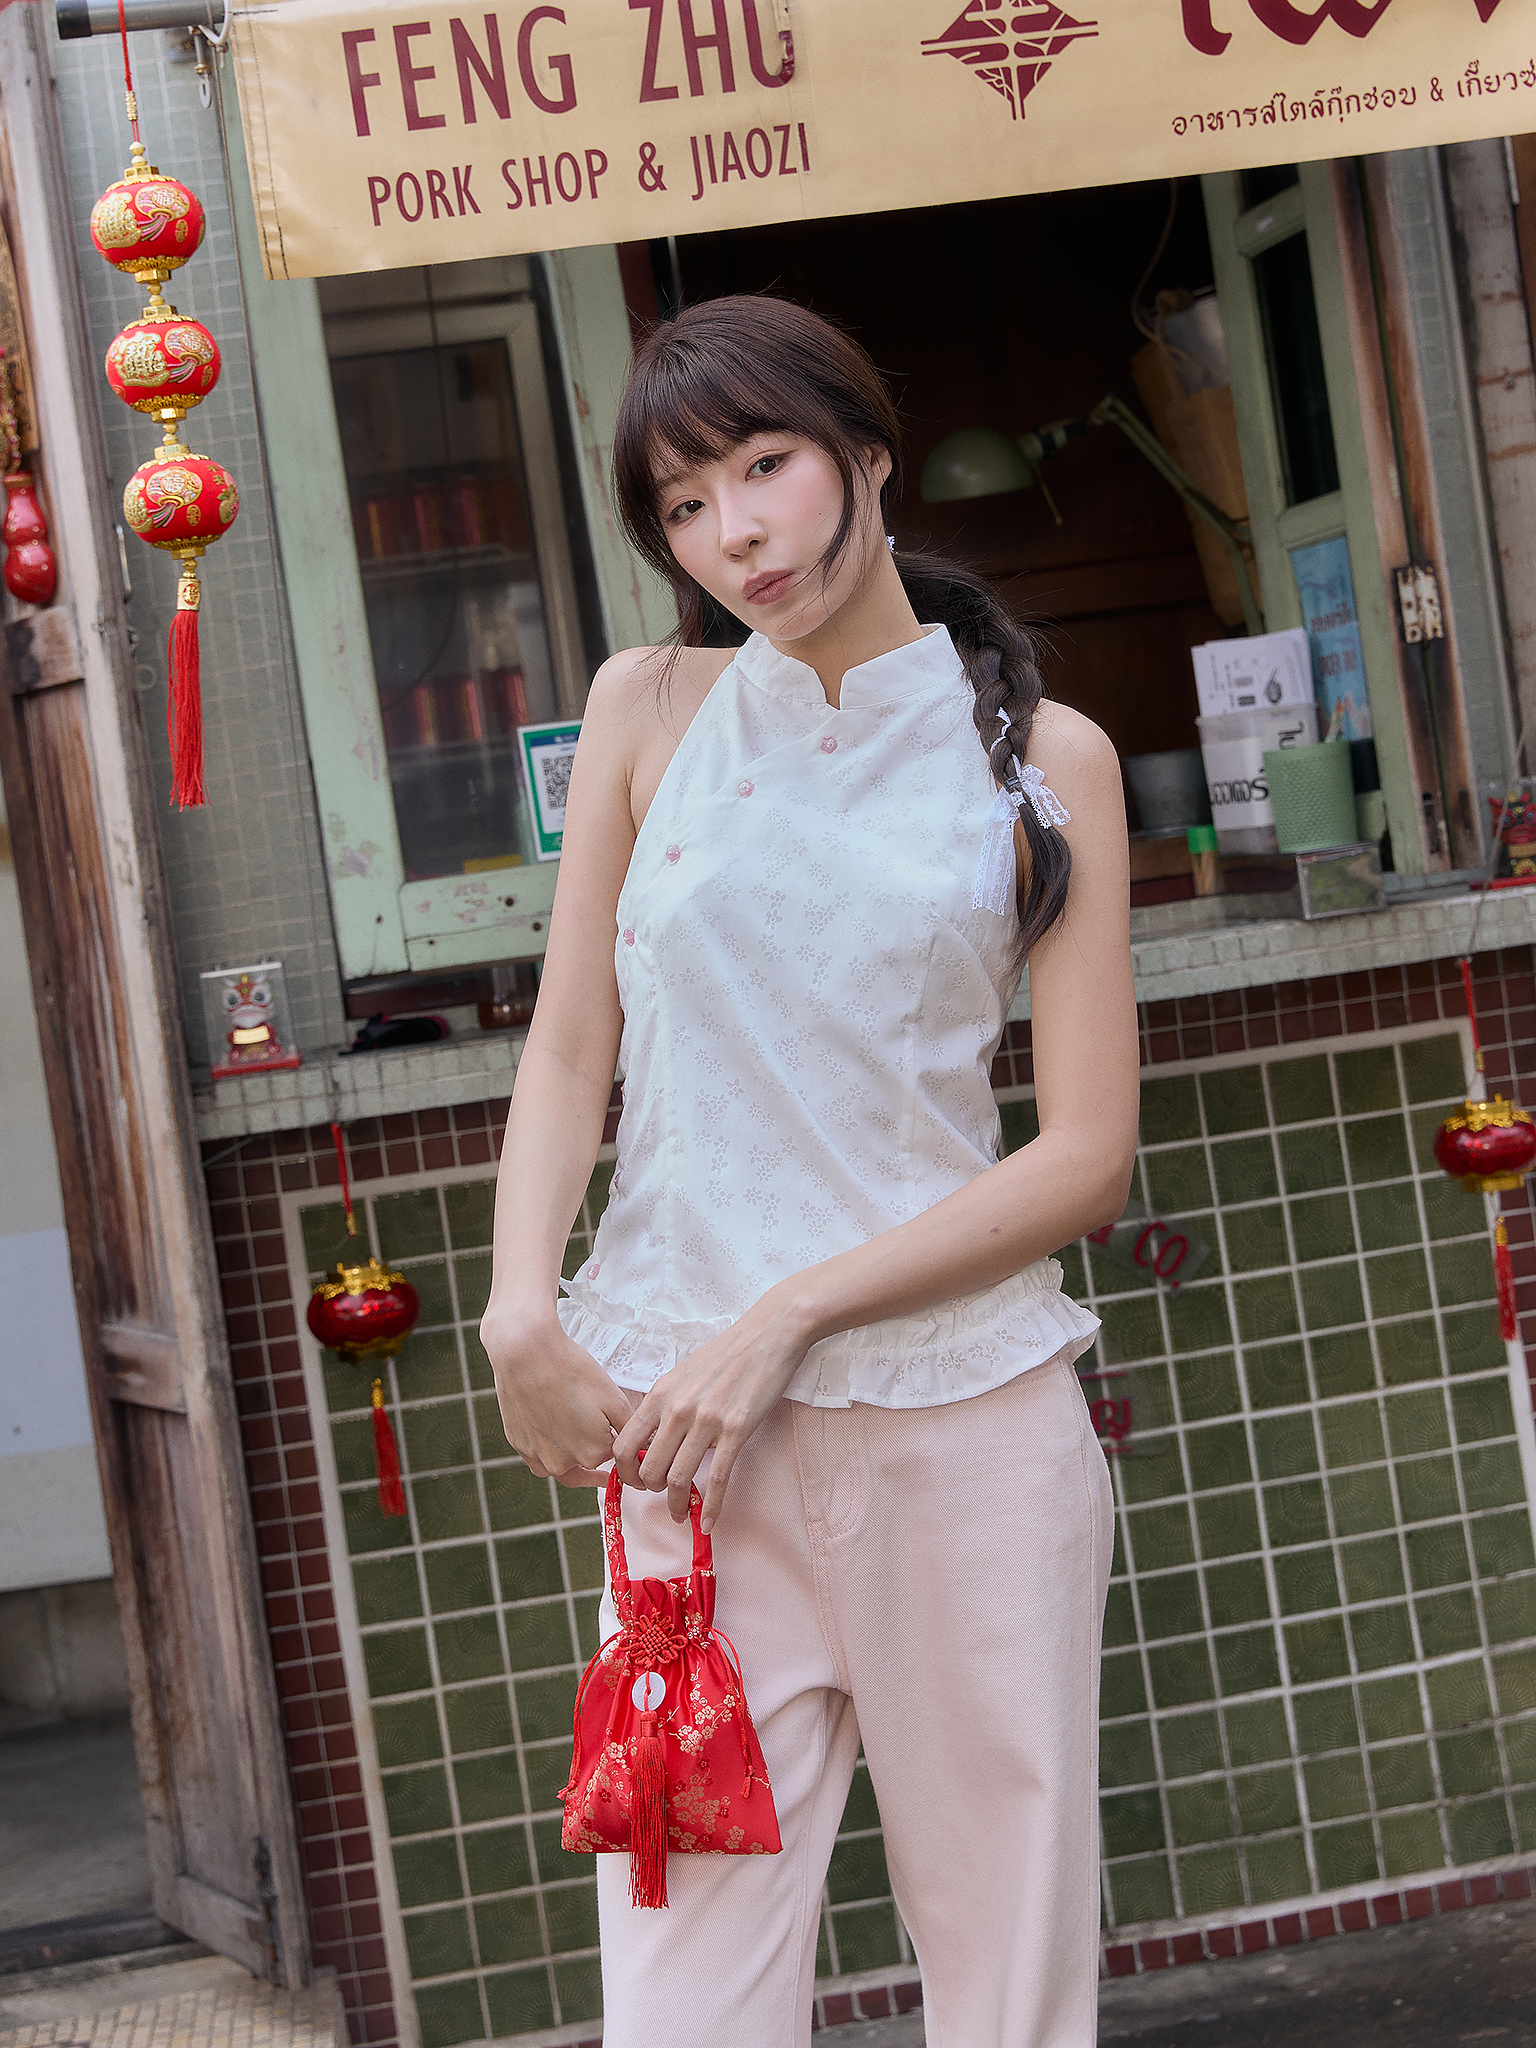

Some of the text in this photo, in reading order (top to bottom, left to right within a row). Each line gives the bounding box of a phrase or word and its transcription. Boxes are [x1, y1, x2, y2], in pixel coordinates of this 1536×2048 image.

[341, 0, 796, 137] FENG ZHU
[1430, 76, 1444, 102] &
[367, 122, 811, 226] PORK SHOP & JIAOZI
